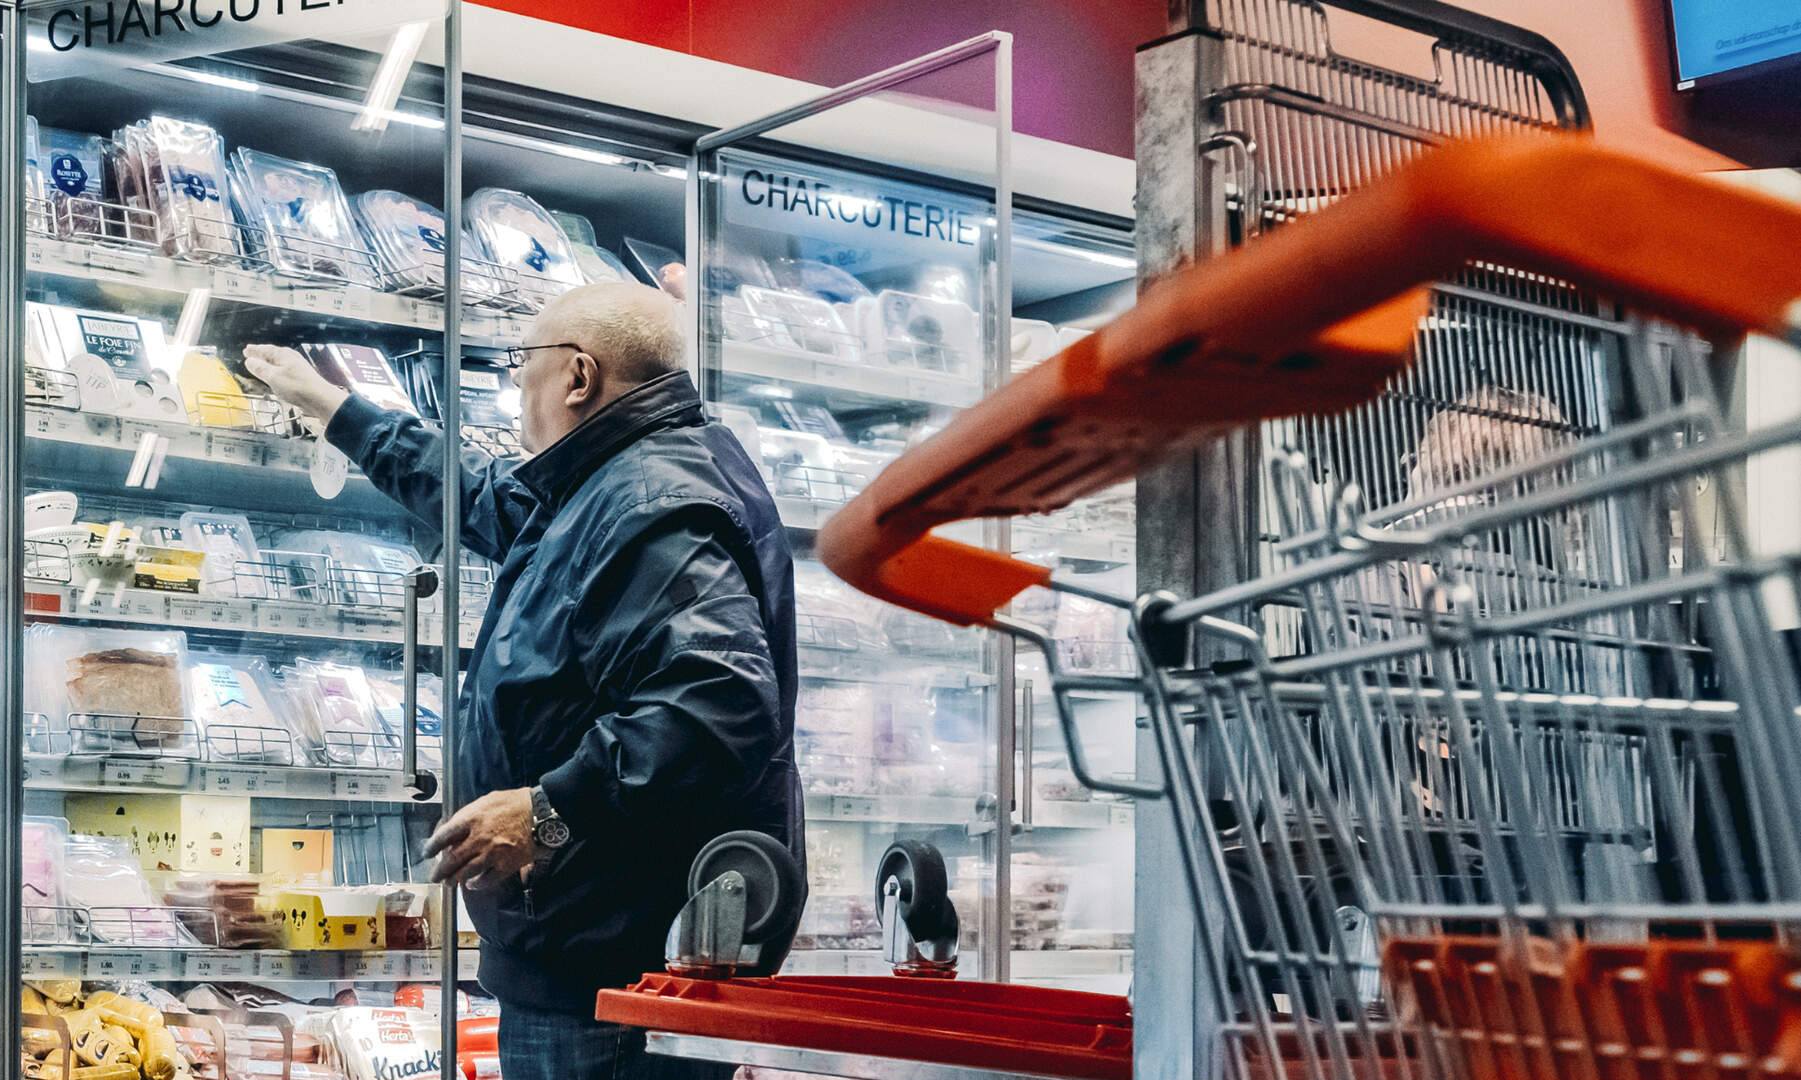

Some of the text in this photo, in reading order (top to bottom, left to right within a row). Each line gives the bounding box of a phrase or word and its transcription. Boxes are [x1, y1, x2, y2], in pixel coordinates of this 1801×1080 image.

[48, 0, 351, 51] CHARCU
[742, 169, 975, 246] CHARCUTERIE
[86, 335, 98, 345] LE
[100, 337, 122, 348] FOIE
[381, 1030, 413, 1042] Herta
